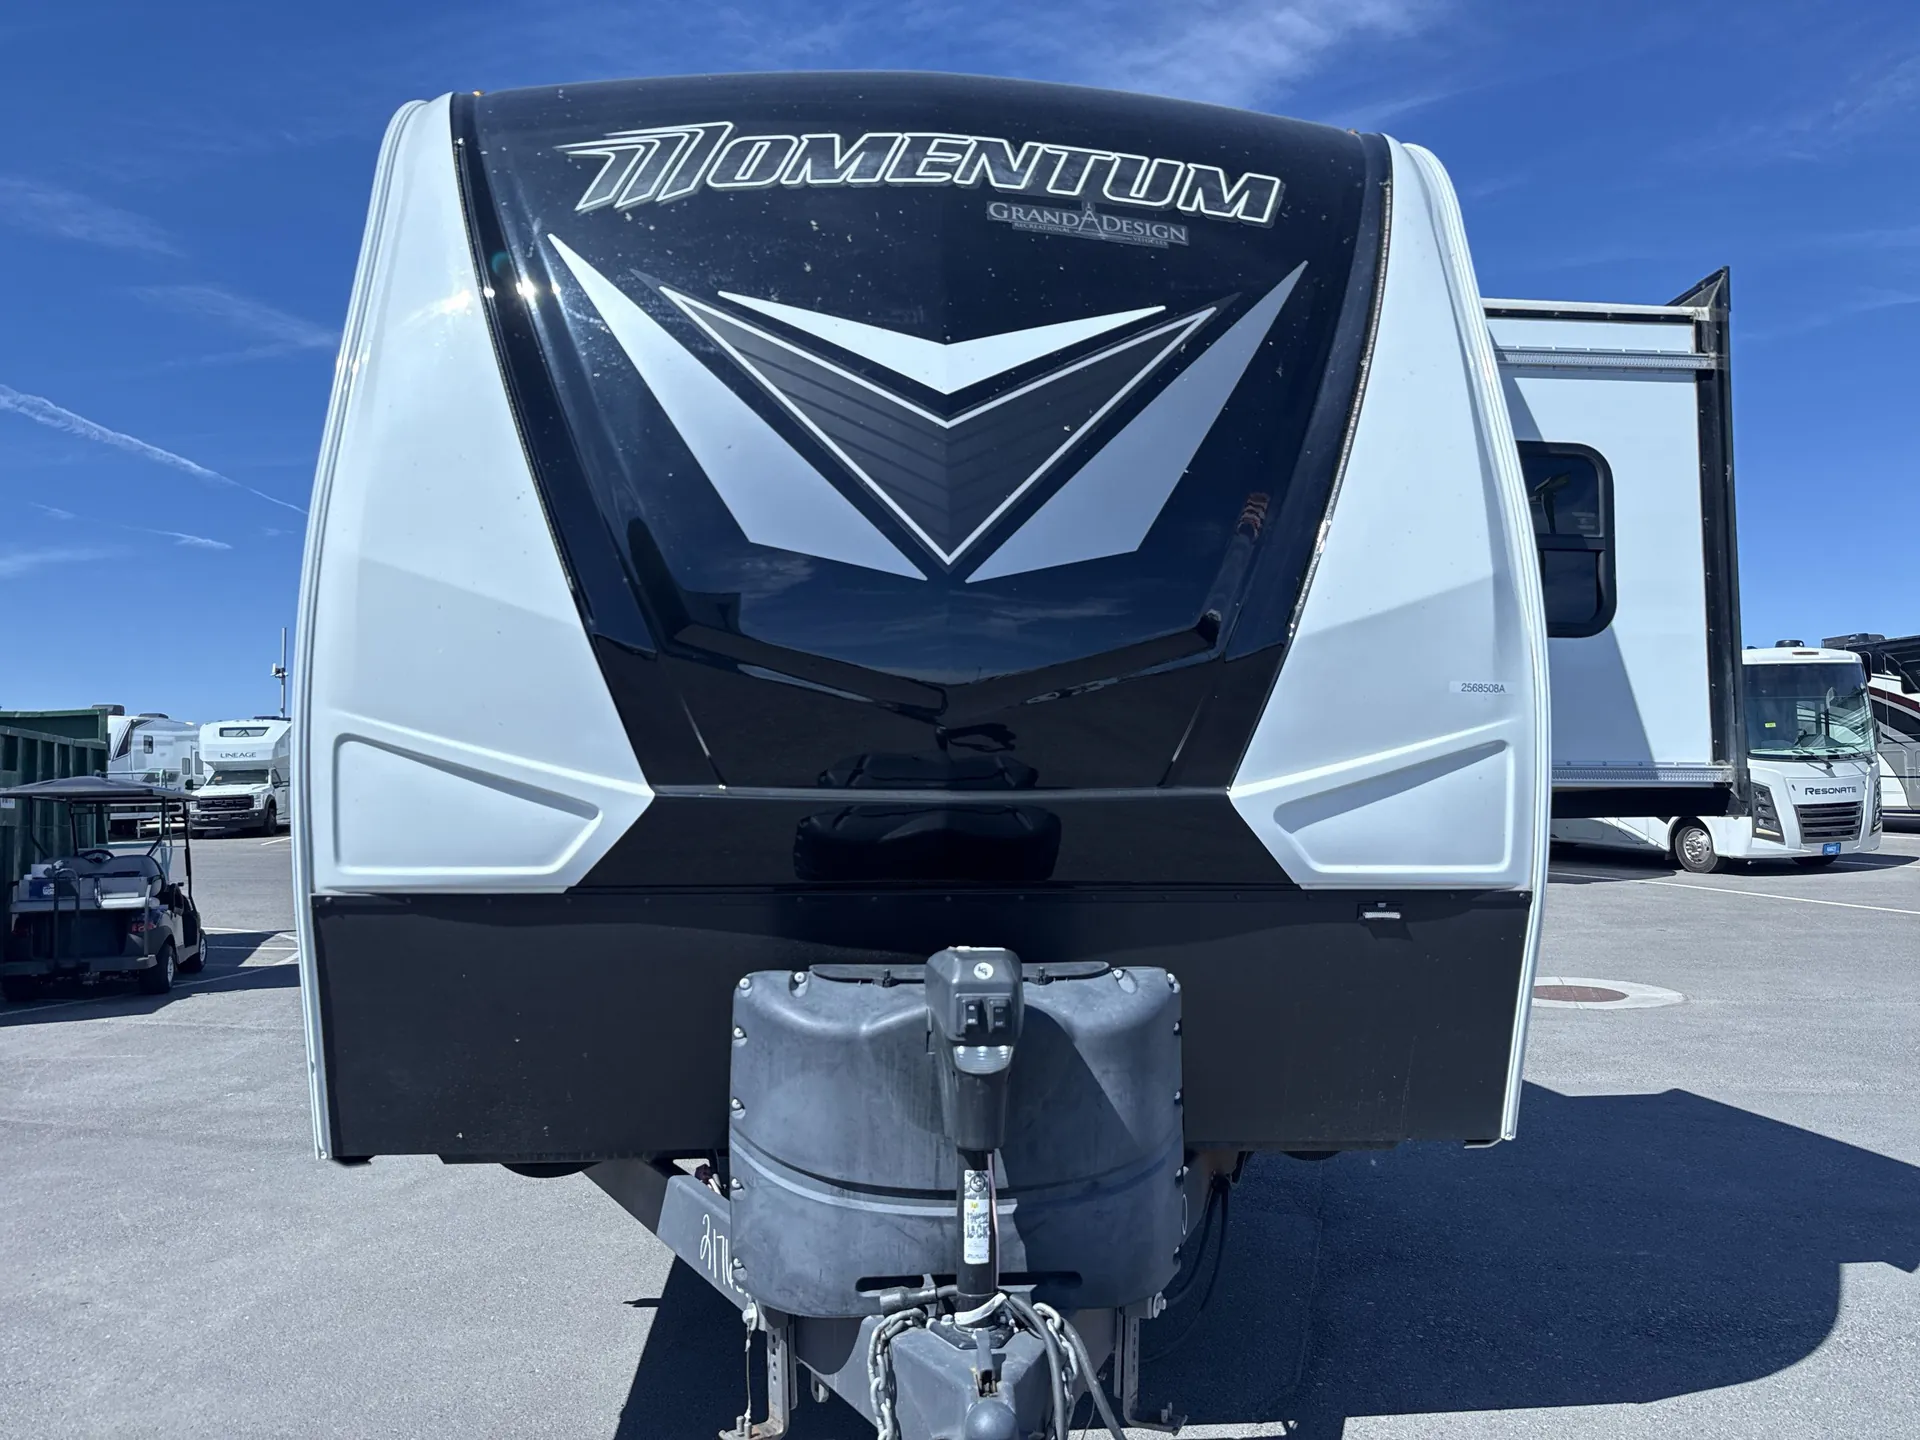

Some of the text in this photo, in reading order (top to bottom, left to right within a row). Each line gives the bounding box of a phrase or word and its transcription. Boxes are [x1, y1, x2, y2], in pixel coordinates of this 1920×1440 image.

[553, 121, 1283, 226] MOMENTUM
[989, 202, 1186, 241] GRAND DESIGN
[1014, 222, 1071, 233] RECREATIONAL
[1461, 683, 1506, 693] 2568508A
[1804, 786, 1857, 796] RESONATE
